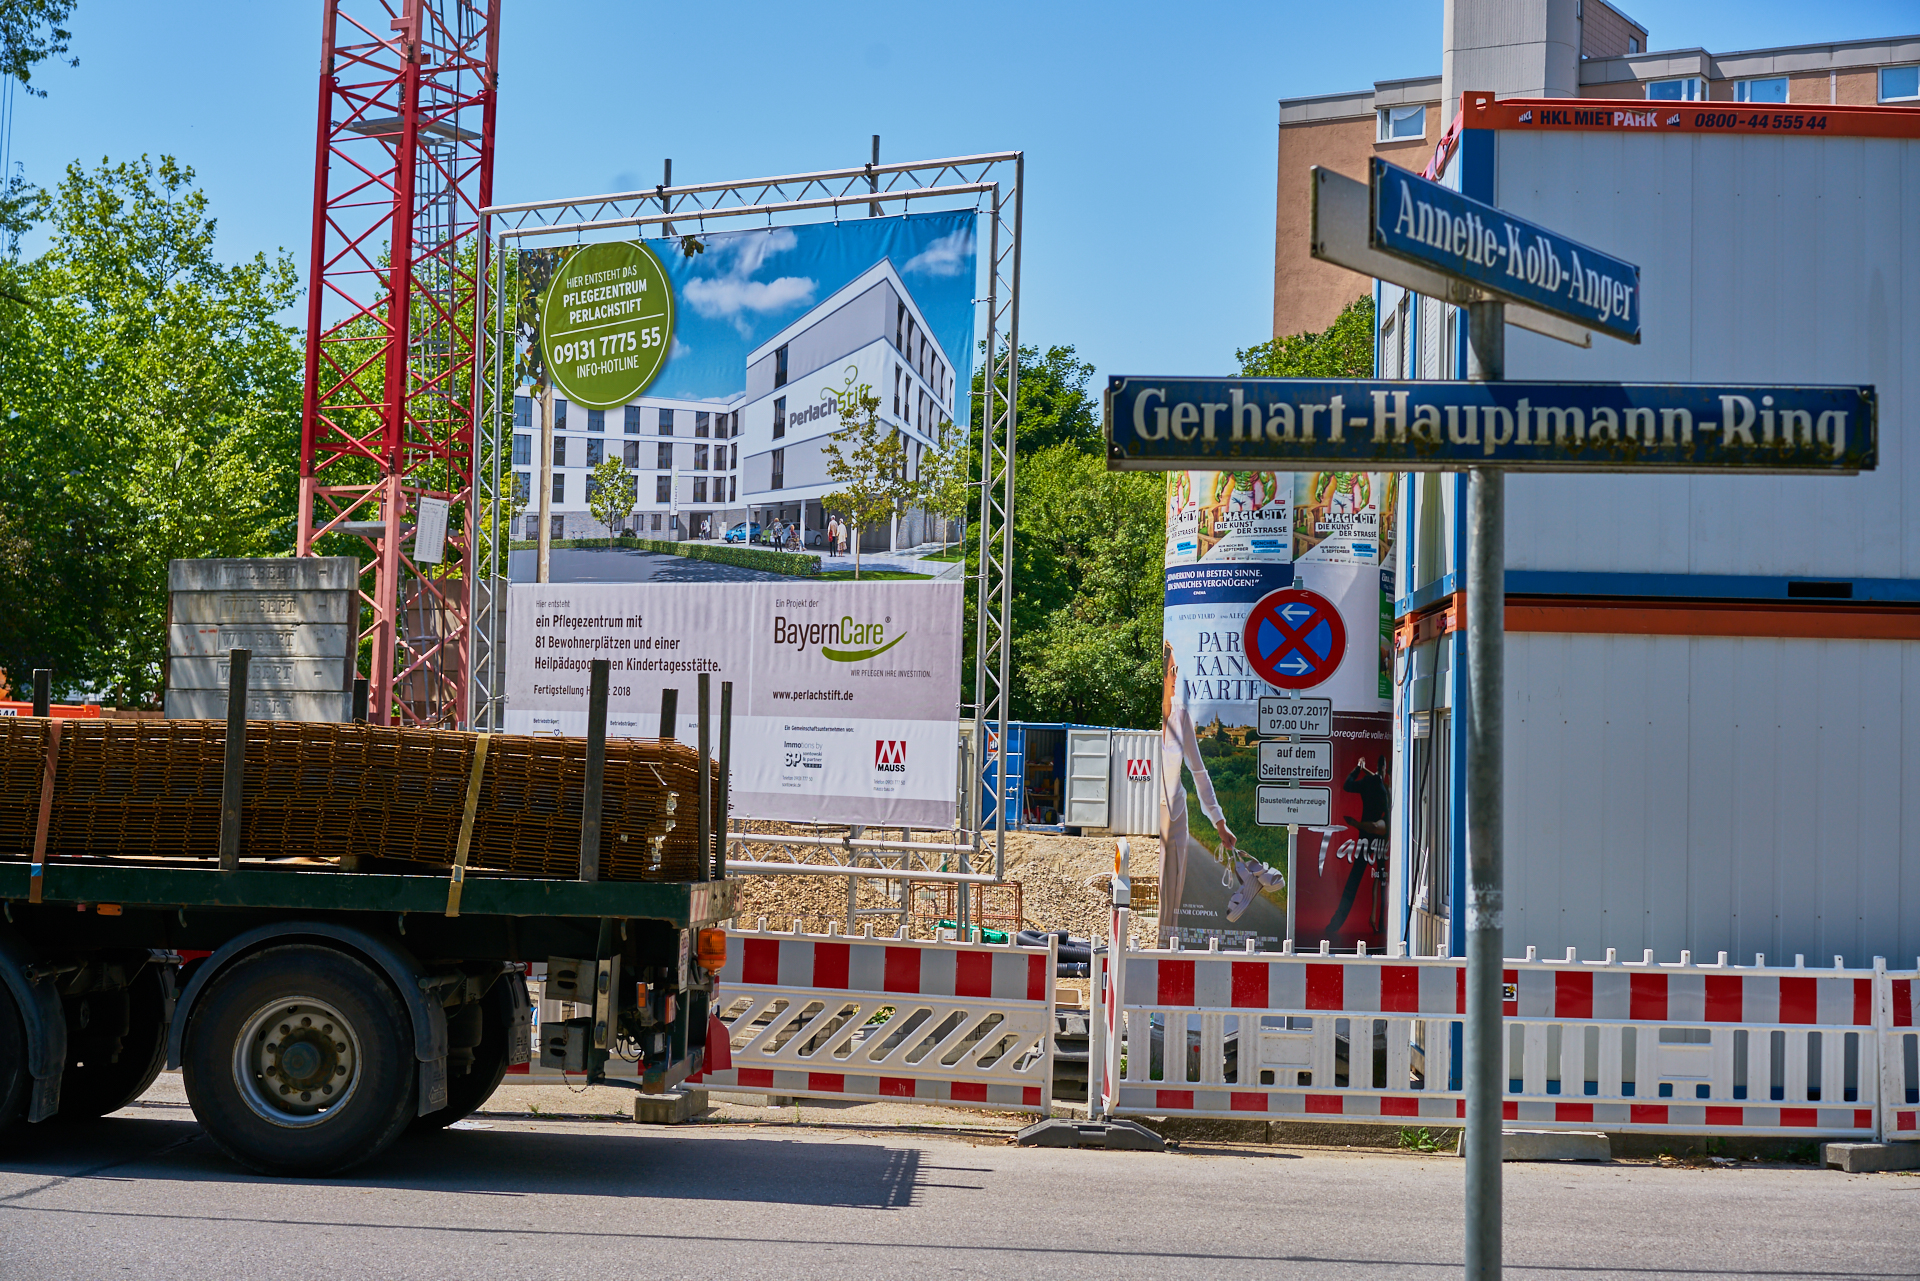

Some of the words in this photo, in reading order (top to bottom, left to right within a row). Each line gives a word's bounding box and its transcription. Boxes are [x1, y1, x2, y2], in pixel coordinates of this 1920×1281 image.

[1540, 111, 1571, 125] HKL
[1772, 115, 1804, 129] 555
[1806, 116, 1827, 130] 44
[1394, 178, 1634, 326] Annette-Kolb-Anger
[566, 276, 584, 289] HIER
[585, 267, 621, 286] ENTSTEHT
[622, 264, 638, 278] DAS
[563, 278, 647, 307] PFLEGEZENTRUM
[569, 297, 642, 324] PERLACHSTIFT
[554, 338, 596, 364] 09131
[599, 330, 637, 356] 7775
[641, 326, 661, 348] 55
[576, 354, 639, 379] INFO-HOTLINE
[1133, 387, 1849, 461] Gerhart-Hauptmann-Ring
[1223, 511, 1260, 522] MAGIC
[1261, 509, 1287, 520] CITY
[1324, 513, 1358, 524] MAGIC
[1359, 514, 1377, 524] CITY
[223, 564, 296, 581] WILBERT
[1196, 570, 1205, 578] IM
[1206, 569, 1233, 578] BESTEN
[1234, 569, 1263, 577] SINNE.
[223, 598, 297, 614] WILBERT
[775, 599, 785, 608] Ein
[786, 599, 808, 610] Projekt
[808, 599, 819, 608] der
[535, 615, 550, 628] ein
[552, 614, 623, 631] Pflegezentrum
[626, 614, 643, 628] mit
[221, 632, 295, 647] WILBERT
[535, 635, 546, 649] 81
[548, 635, 631, 652] Bewohnerplätzen
[633, 636, 652, 650] und
[654, 636, 681, 651] einer
[1197, 631, 1244, 653] PAR
[626, 657, 722, 675] Kindertagesstätte.
[861, 669, 884, 677] PFLEGEN
[898, 670, 932, 678] INVESTITION.
[1193, 655, 1252, 677] KAN
[533, 685, 584, 698] Fertigstellung
[612, 686, 631, 697] 2018
[772, 689, 854, 702] www.perlachstift.de
[1261, 705, 1274, 714] ab
[1276, 705, 1329, 717] 03.07.2017
[1269, 719, 1297, 731] 07:00
[1299, 720, 1320, 732] Uhr
[1277, 746, 1293, 758] auf
[1294, 747, 1316, 759] dem
[878, 763, 906, 773] MAUSS
[1261, 763, 1330, 778] Seitenstreifen
[1259, 796, 1327, 807] Baustellenfahrzeuge
[1287, 806, 1299, 814] frei
[1192, 909, 1219, 917] COPPOLA
